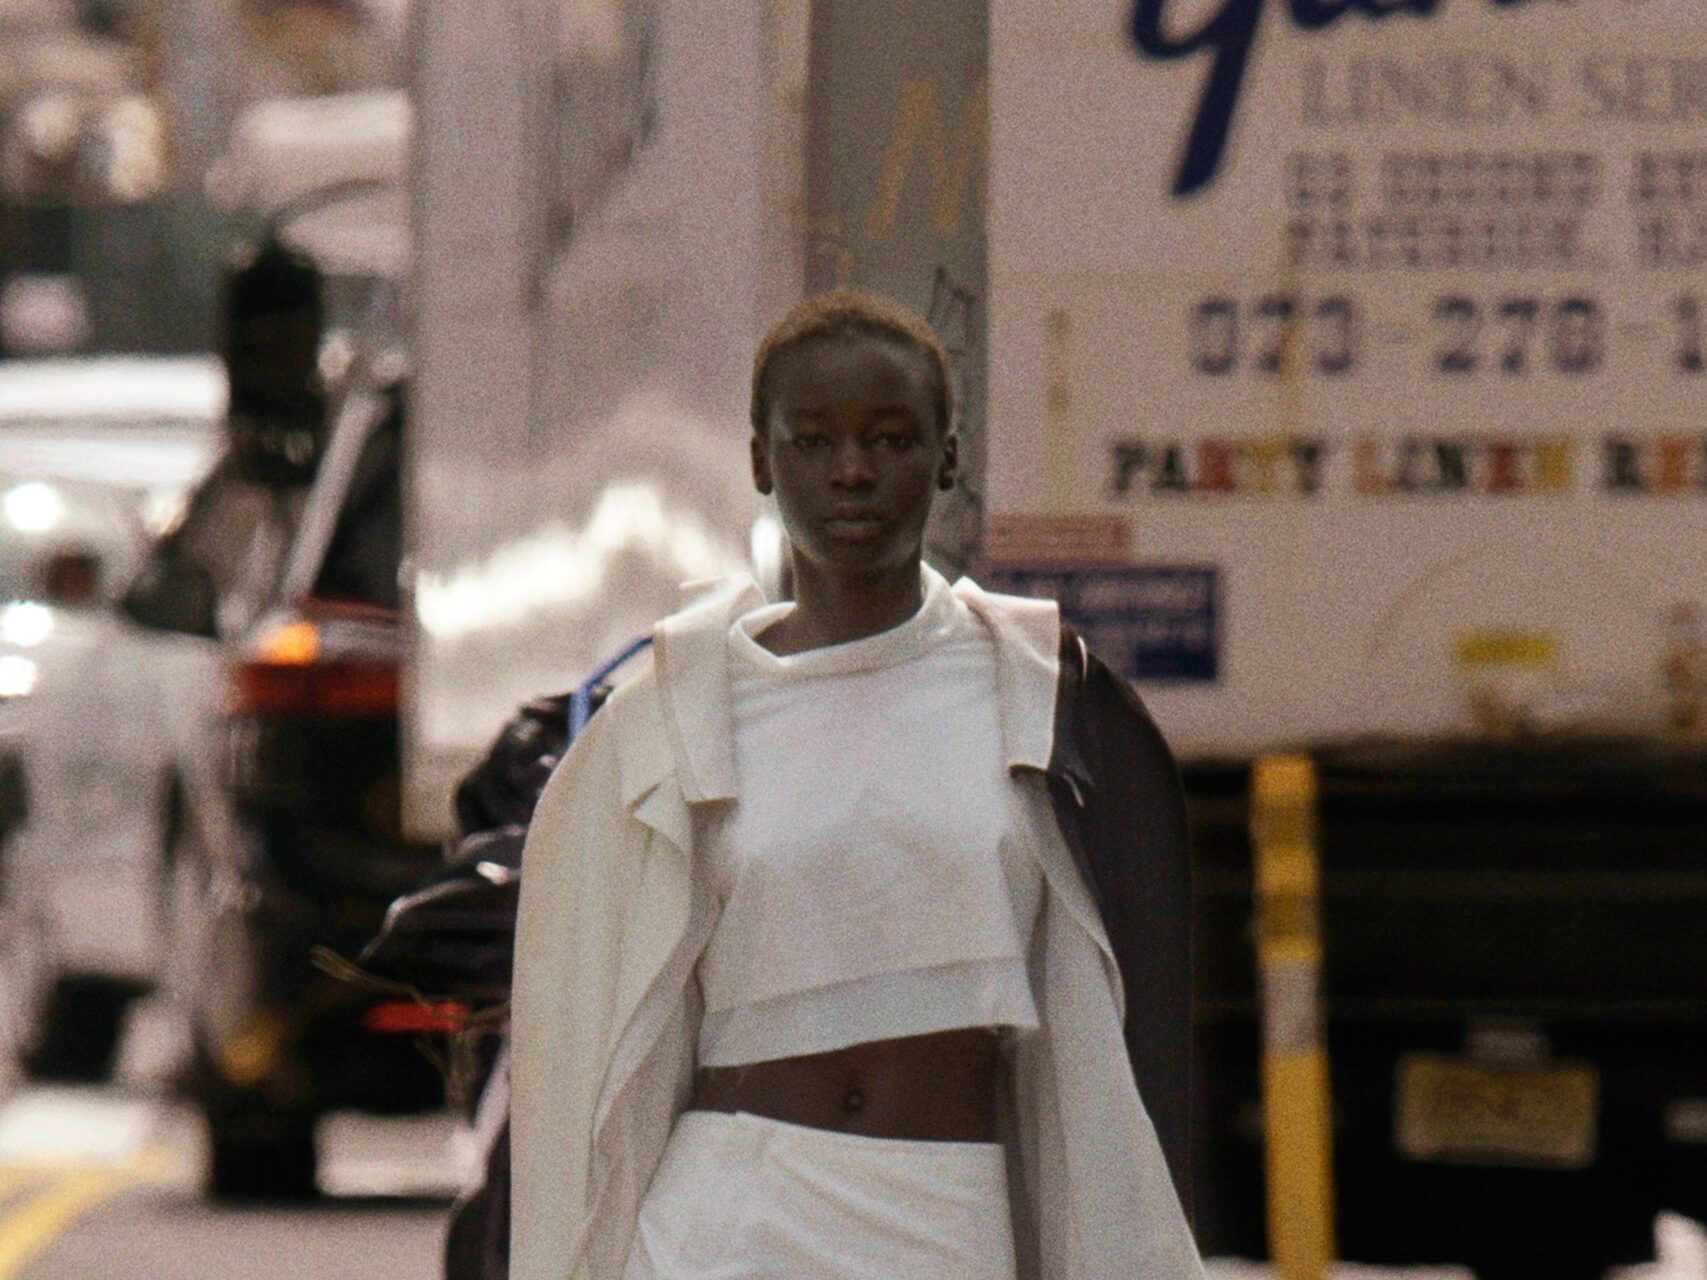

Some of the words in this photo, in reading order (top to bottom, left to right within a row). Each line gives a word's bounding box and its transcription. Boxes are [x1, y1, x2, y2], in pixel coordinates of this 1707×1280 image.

[1300, 56, 1551, 124] LINEN
[1108, 437, 1328, 497] PARTY
[1352, 437, 1572, 497] LINEN
[1601, 437, 1707, 497] RE
